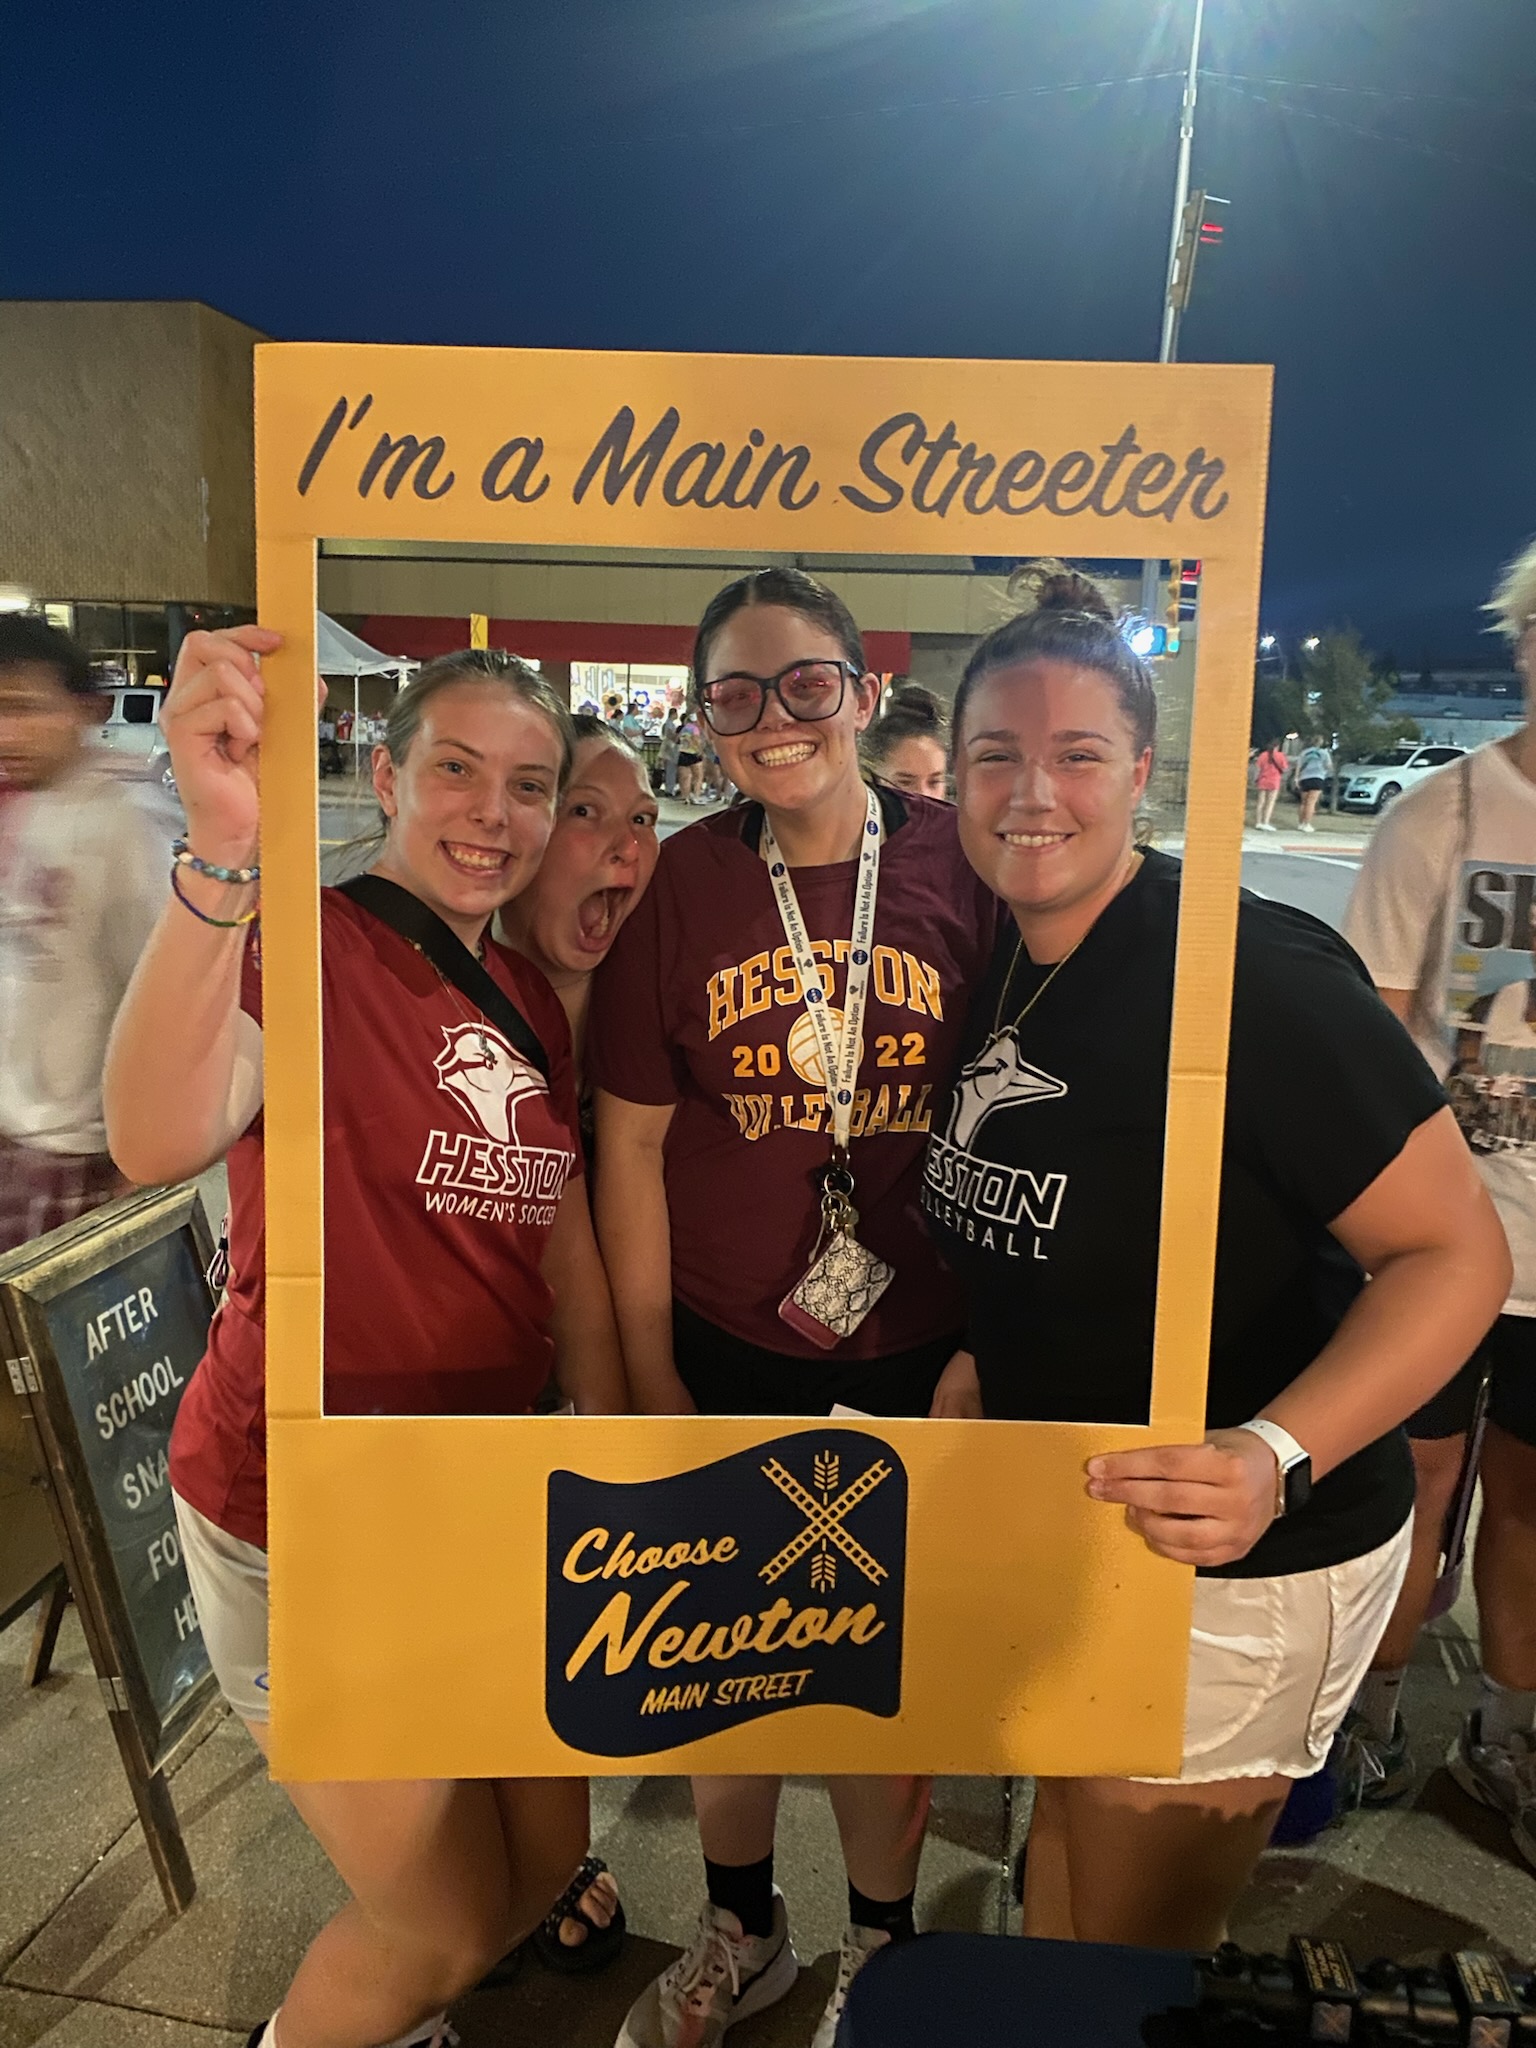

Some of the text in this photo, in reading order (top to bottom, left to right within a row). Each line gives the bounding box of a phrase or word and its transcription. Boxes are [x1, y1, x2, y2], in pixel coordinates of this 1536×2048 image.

[297, 394, 1229, 523] I'm a Main Streeter
[861, 891, 871, 900] An
[862, 869, 873, 891] Option
[860, 901, 870, 913] Not
[856, 920, 869, 943] Failure
[814, 1009, 827, 1034] Failure
[823, 1042, 833, 1054] Not
[847, 1026, 858, 1036] An
[848, 1003, 860, 1026] Option
[732, 1032, 926, 1077] 20 22
[845, 1038, 856, 1051] Not
[841, 1059, 854, 1083] Failure
[415, 1129, 575, 1200] HESSTON
[923, 1132, 1068, 1230] ESSTON
[425, 1191, 516, 1223] WOMEN'S
[87, 1287, 159, 1361] AFTER
[95, 1355, 184, 1440] SCHOOL
[123, 1449, 169, 1510] SNA
[148, 1525, 181, 1582] FO
[562, 1527, 739, 1584] Choose
[174, 1593, 199, 1641] HE
[565, 1579, 886, 1682] Newton
[640, 1669, 815, 1716] MAIN STREET
